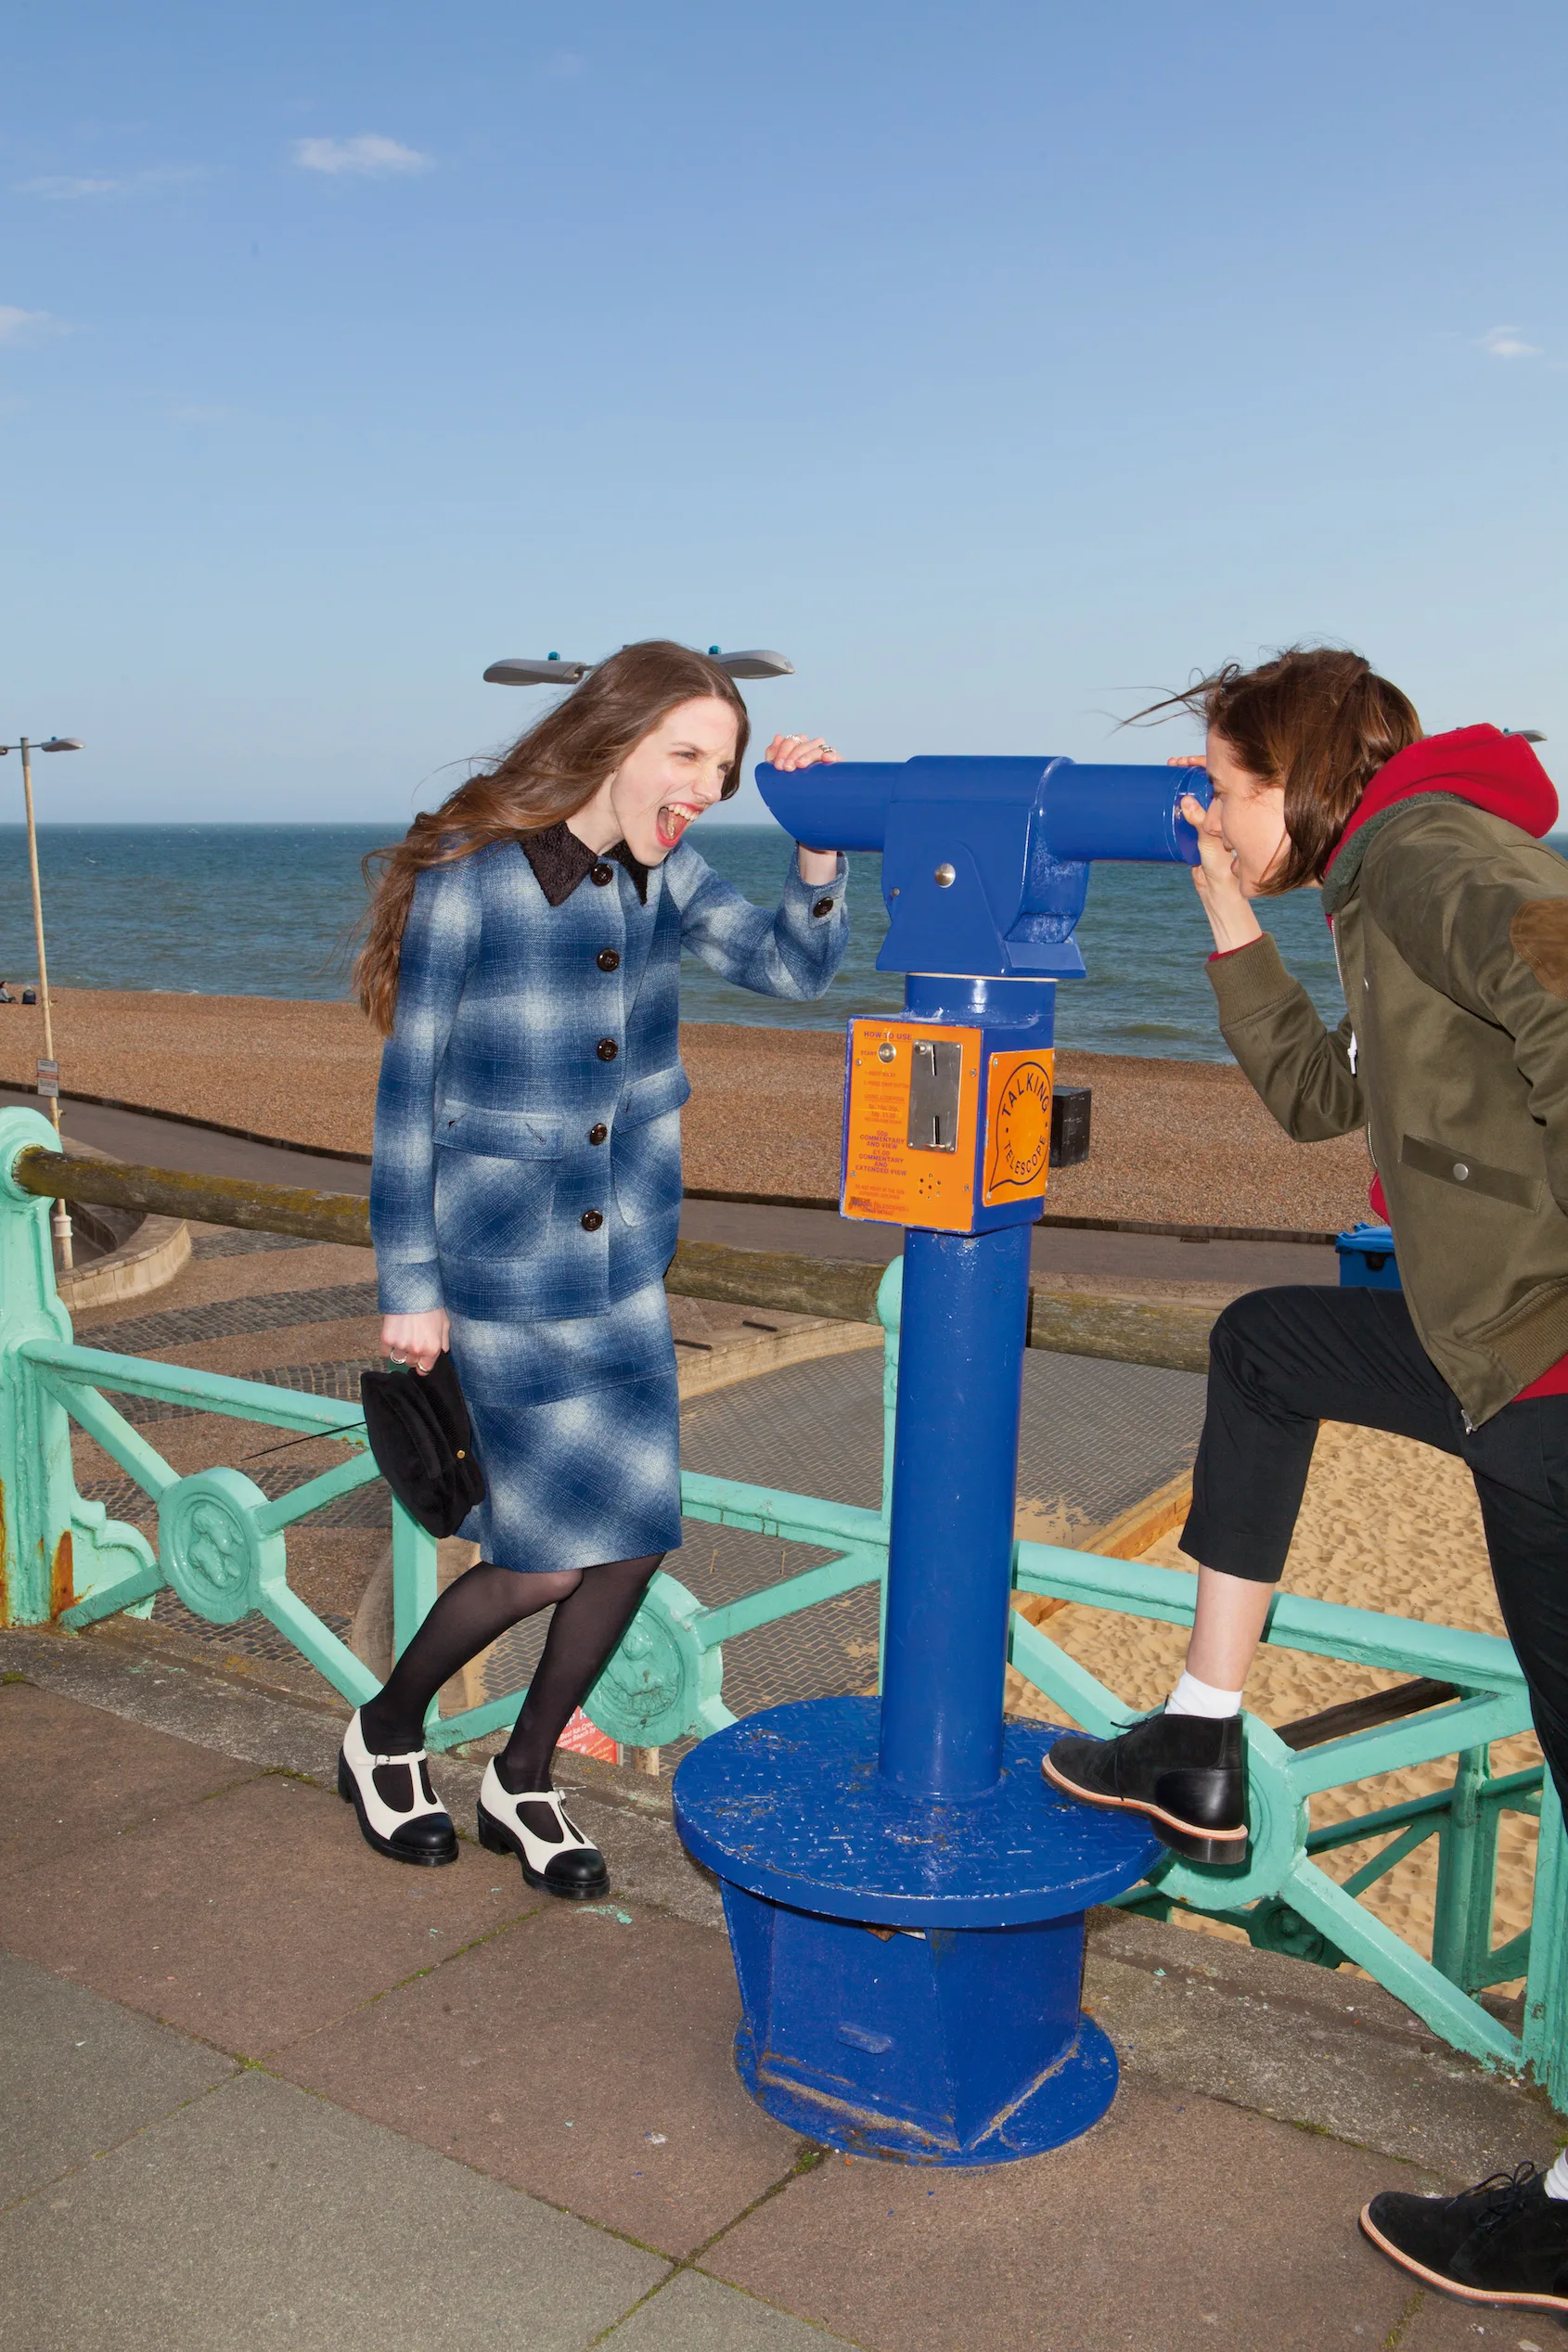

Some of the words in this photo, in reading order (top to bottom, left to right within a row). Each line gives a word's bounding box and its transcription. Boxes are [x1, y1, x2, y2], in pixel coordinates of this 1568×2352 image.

[1002, 1072, 1049, 1117] TALKING
[859, 1134, 906, 1144] COMMENTARY
[858, 1153, 904, 1163] COMMENTARY
[1004, 1135, 1047, 1176] TELESCOPE
[855, 1164, 889, 1174] EXTENDED
